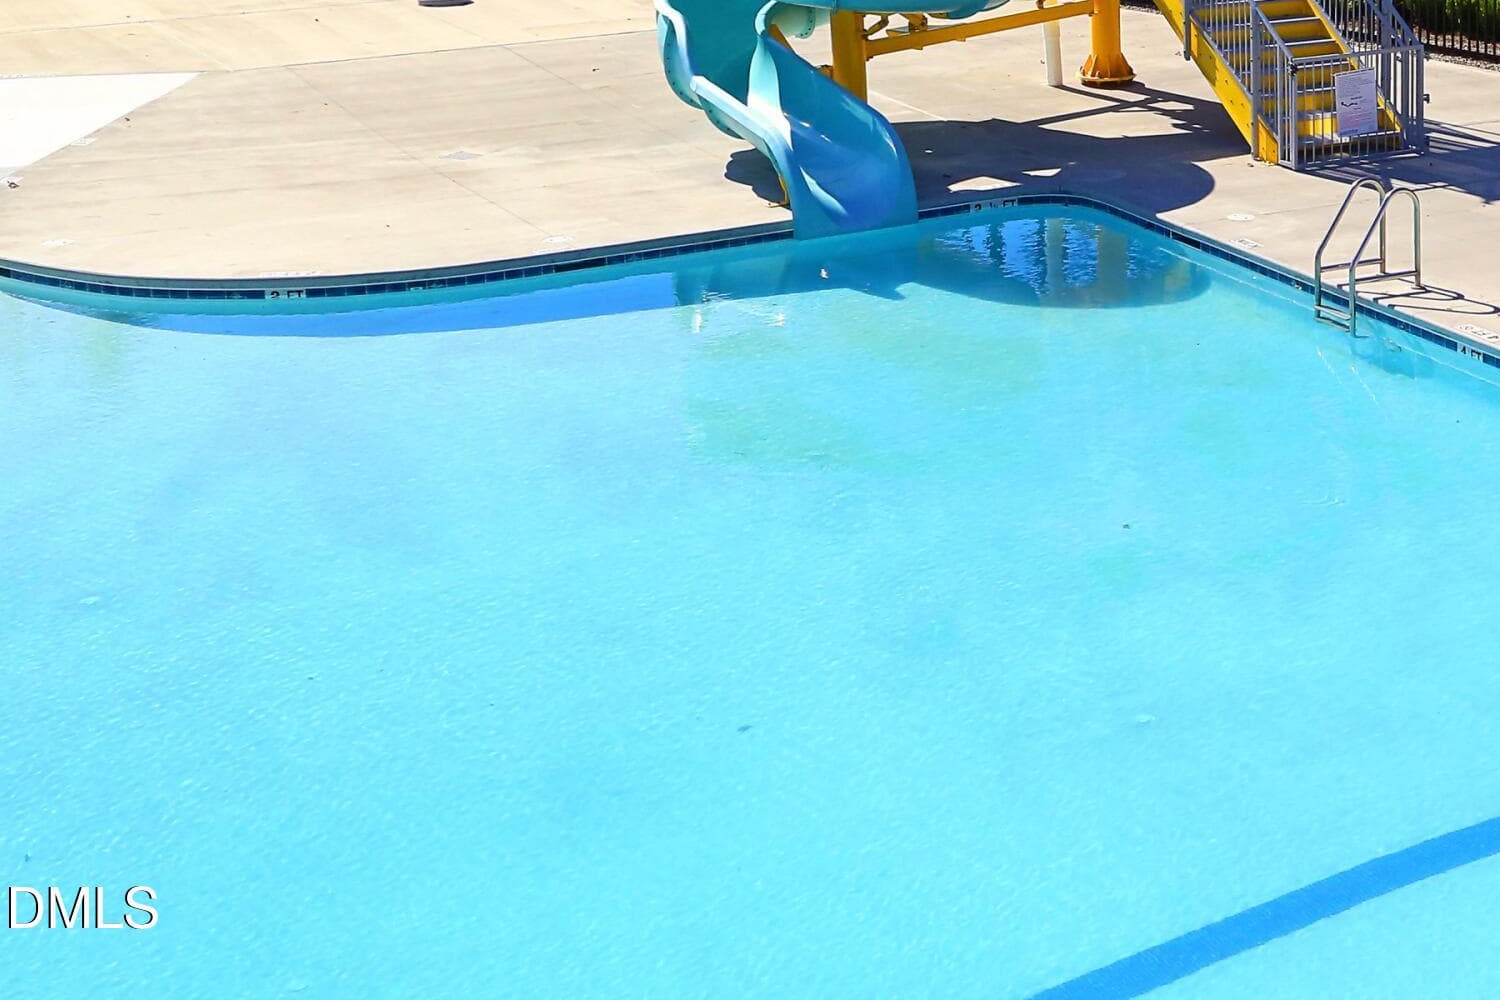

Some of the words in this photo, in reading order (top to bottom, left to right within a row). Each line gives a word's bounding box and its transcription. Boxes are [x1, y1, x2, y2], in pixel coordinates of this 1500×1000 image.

[286, 289, 304, 299] FT
[1460, 345, 1467, 355] 4
[1470, 348, 1482, 361] FT
